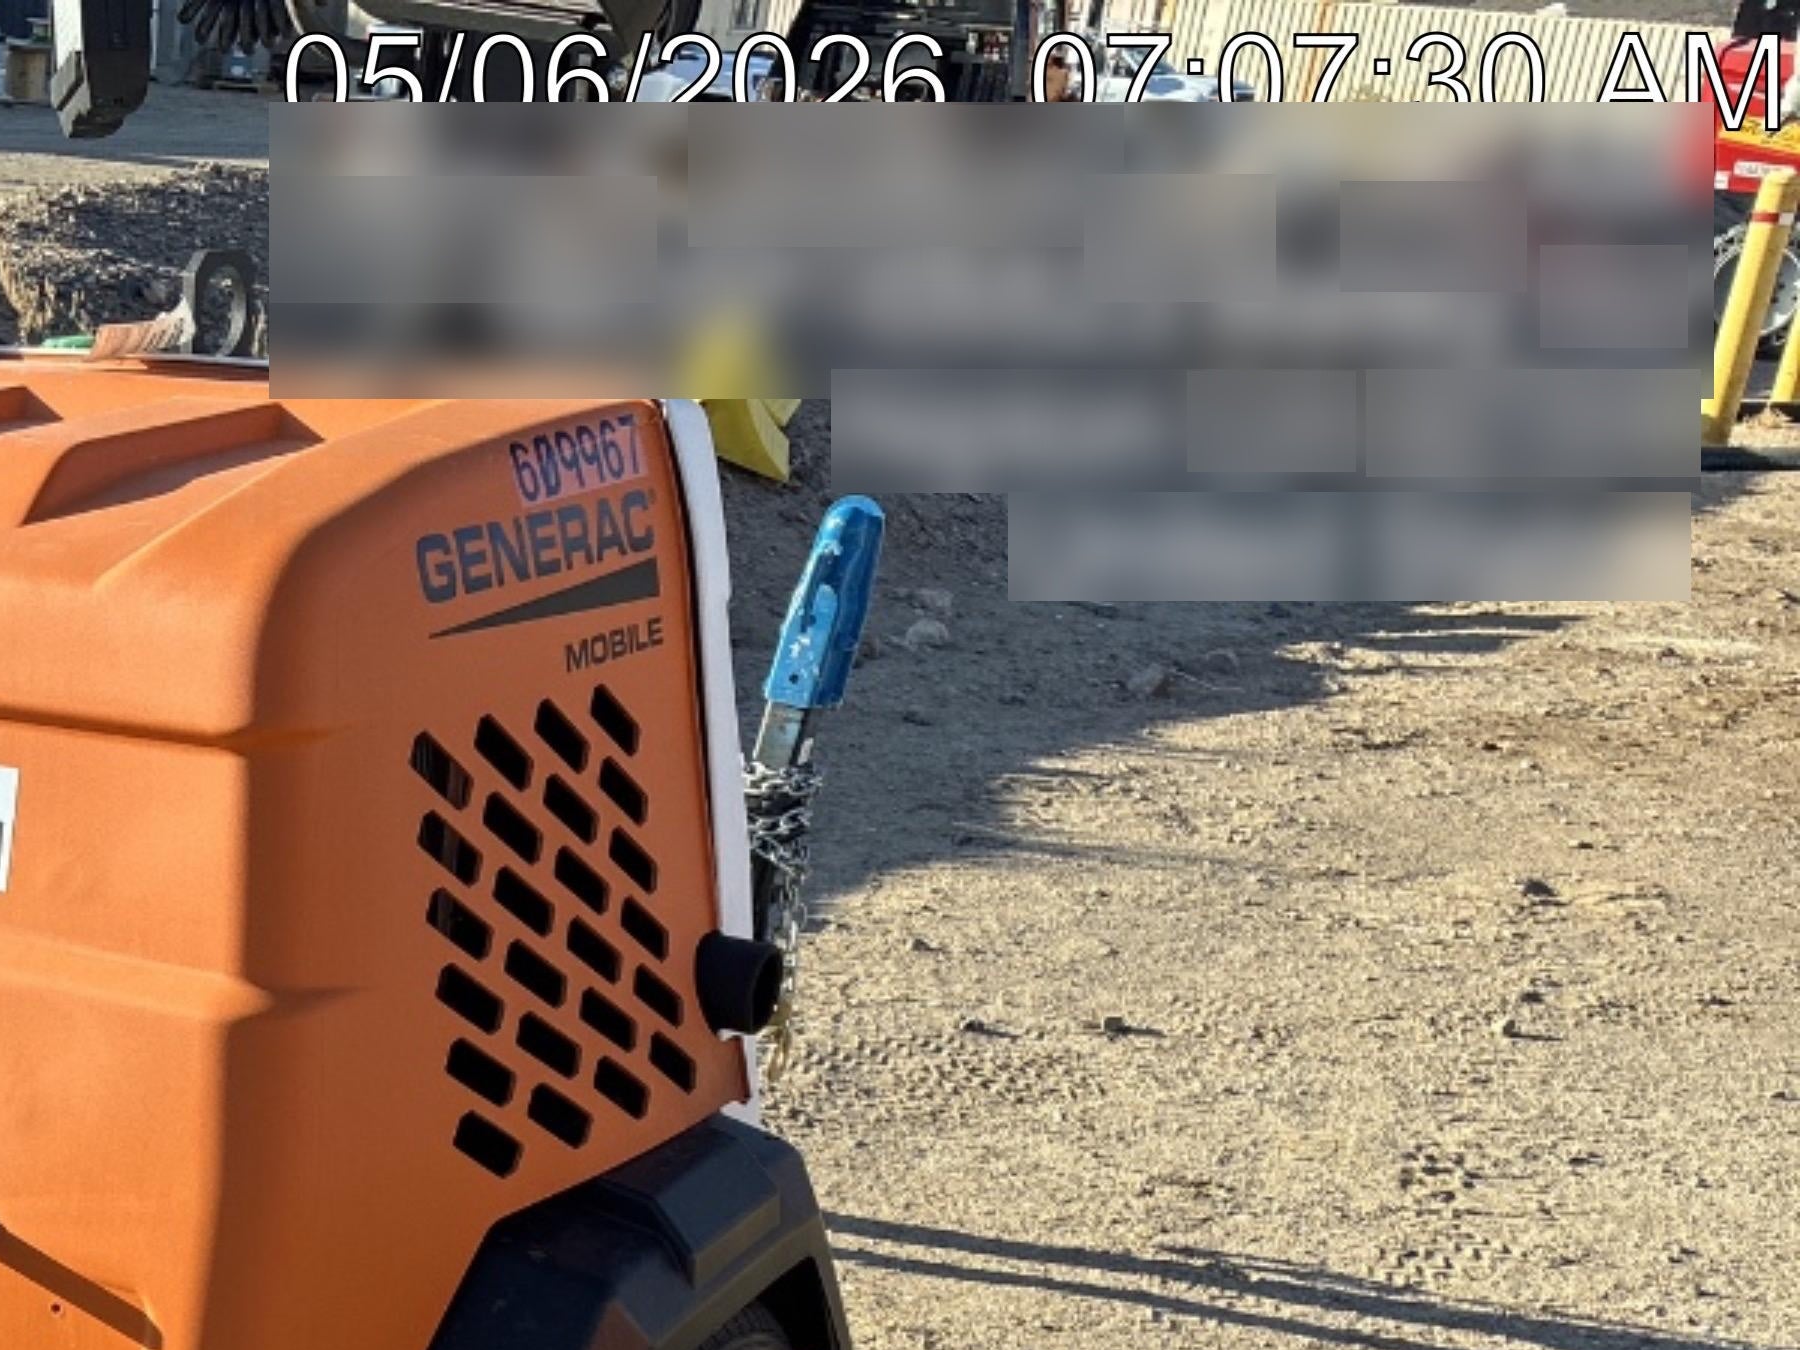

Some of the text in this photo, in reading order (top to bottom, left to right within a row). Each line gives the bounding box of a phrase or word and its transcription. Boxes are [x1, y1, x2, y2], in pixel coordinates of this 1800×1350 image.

[509, 414, 640, 502] 609967
[415, 489, 655, 605] GENERAC
[563, 616, 665, 673] MOBILE
